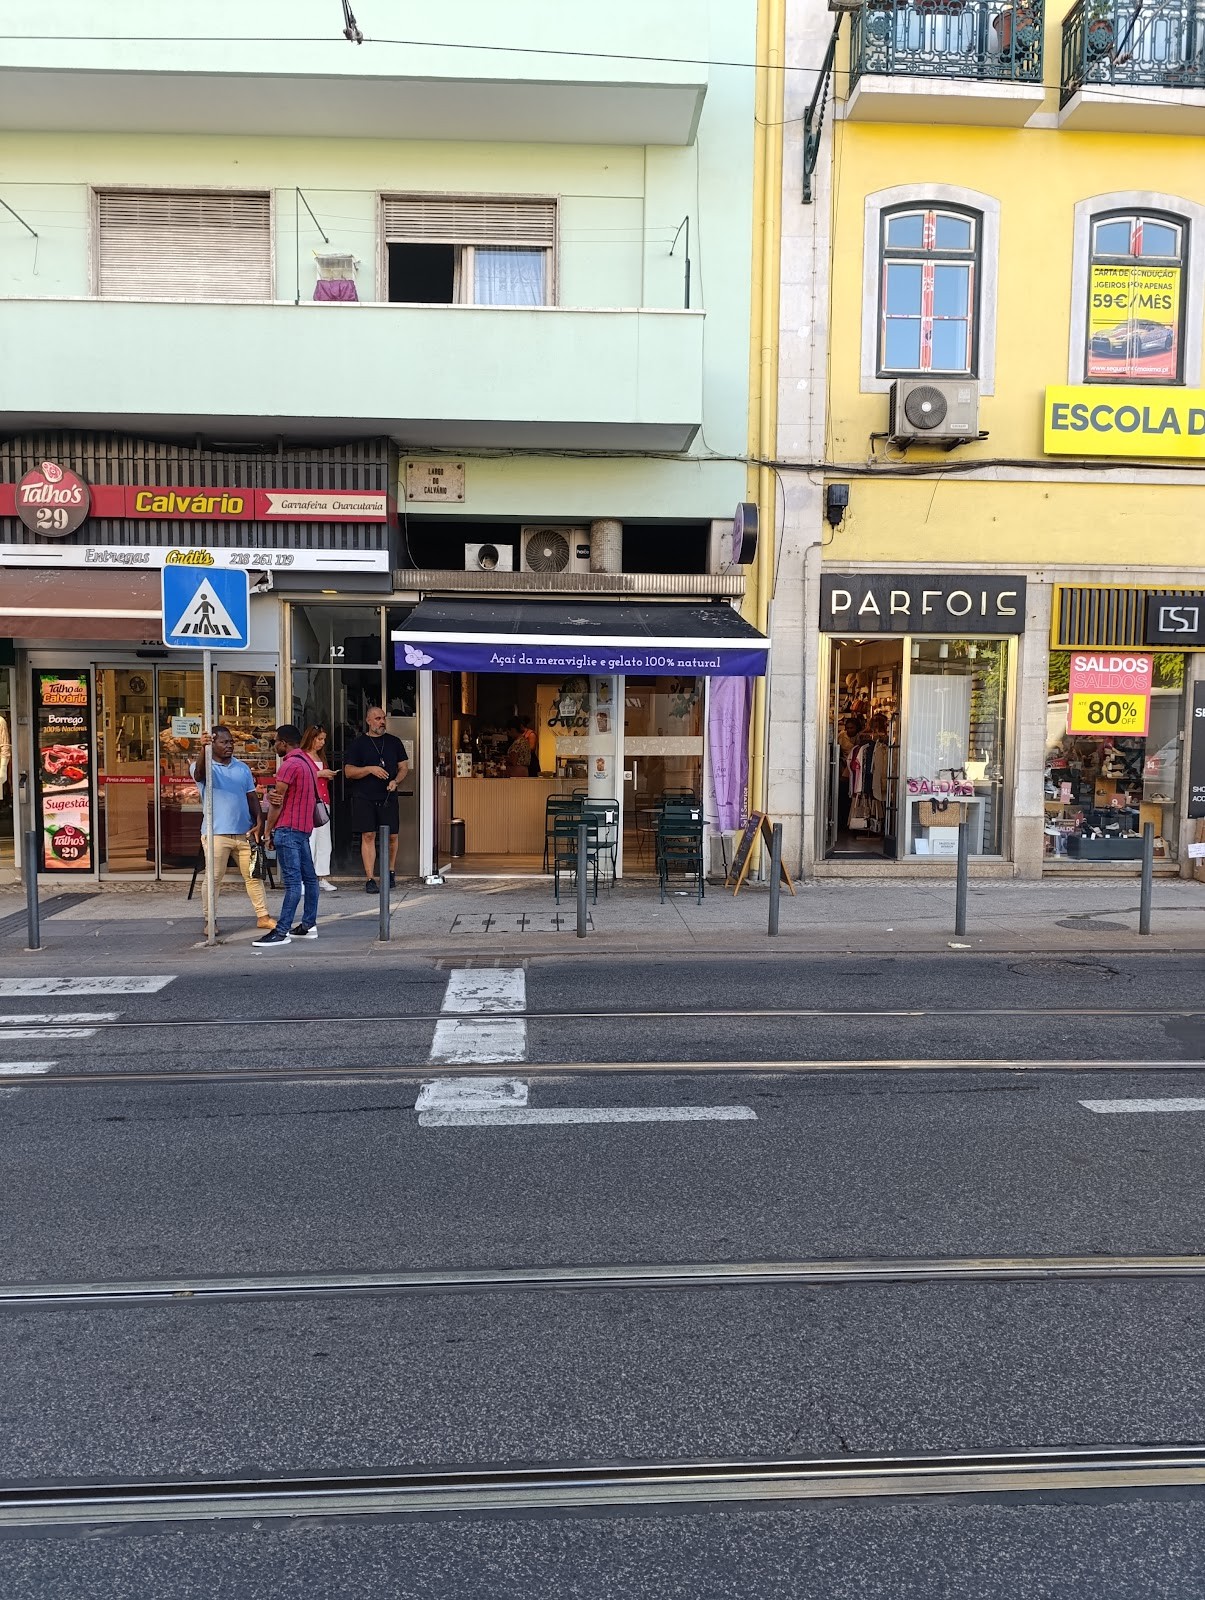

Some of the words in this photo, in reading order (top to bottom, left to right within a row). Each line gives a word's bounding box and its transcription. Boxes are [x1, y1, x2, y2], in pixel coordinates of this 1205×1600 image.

[1119, 269, 1128, 277] DE
[1051, 402, 1181, 435] ESCOLA
[428, 468, 444, 476] LARGO
[432, 477, 439, 485] DO
[20, 482, 82, 504] Talho's
[424, 485, 448, 495] CALVÁRIO
[135, 491, 244, 515] Calvário
[281, 500, 327, 511] Garrafeira
[332, 500, 383, 511] Charcutaria
[36, 507, 69, 530] 29
[84, 549, 150, 565] Entregas
[165, 549, 215, 566] Grátis
[229, 553, 251, 565] 218
[252, 553, 273, 566] 261
[274, 554, 295, 566] 119
[831, 589, 1017, 616] PARFOIS
[329, 646, 345, 657] 12
[489, 652, 516, 666] Açaí
[518, 653, 533, 665] da
[536, 654, 597, 669] meraviglie
[600, 659, 606, 667] e
[608, 656, 643, 669] gelato
[645, 656, 675, 668] 100%
[677, 656, 721, 668] natural
[1074, 656, 1149, 673] SALDOS
[49, 683, 74, 693] Talho
[1073, 673, 1148, 690] SALDOS
[43, 693, 87, 704] Calvário
[1087, 700, 1137, 724] 80%
[1121, 717, 1137, 725] OFF
[48, 714, 84, 726] Borrego
[43, 725, 61, 733] 100%
[908, 780, 974, 794] SALDOS
[740, 813, 748, 828] Self
[53, 834, 85, 846] Talho's
[61, 847, 79, 858] 29
